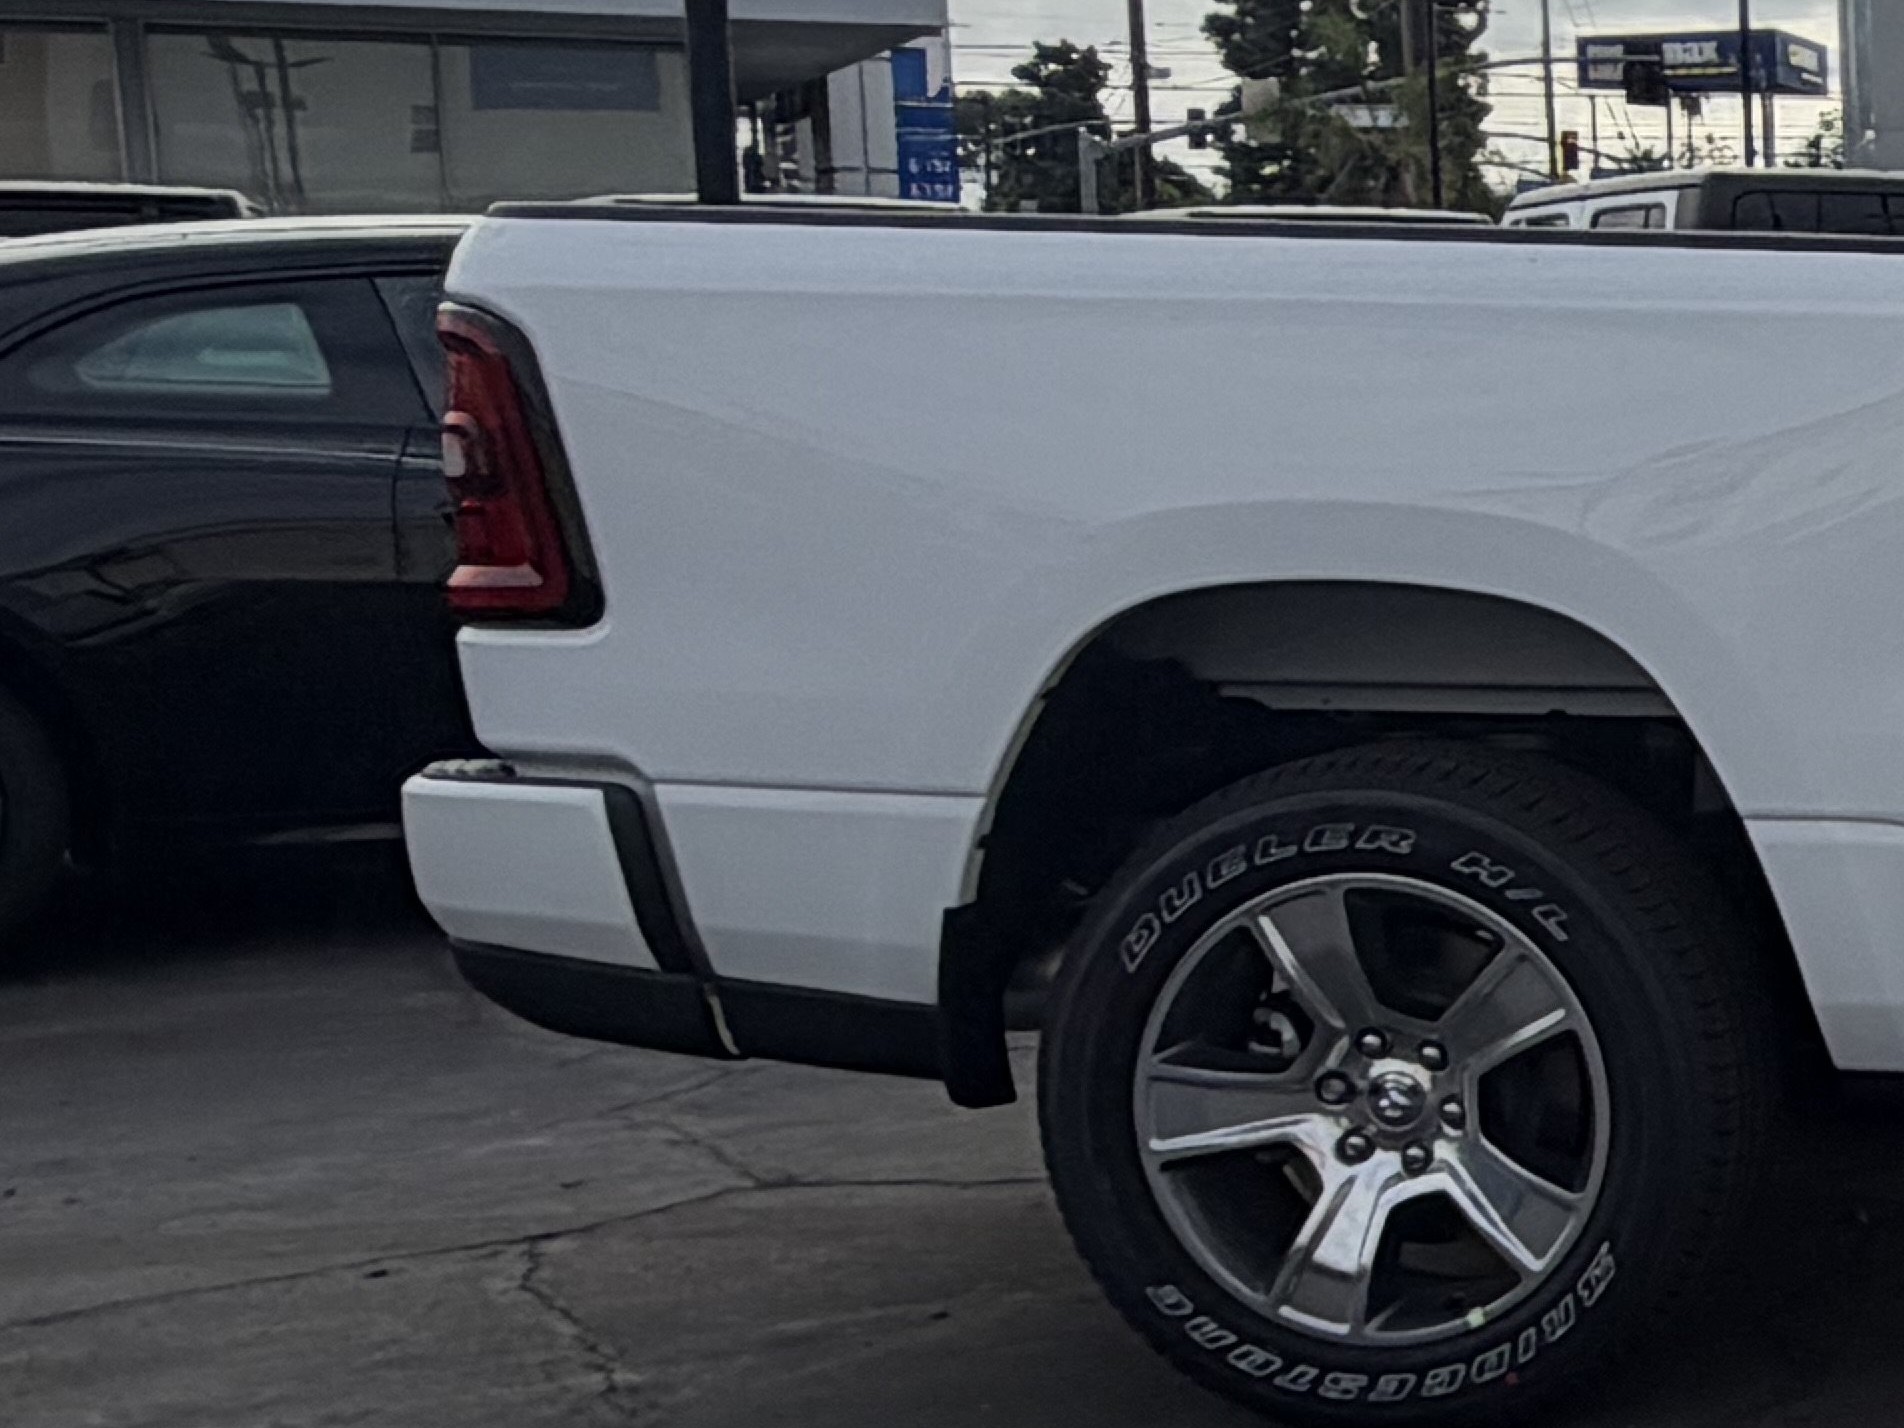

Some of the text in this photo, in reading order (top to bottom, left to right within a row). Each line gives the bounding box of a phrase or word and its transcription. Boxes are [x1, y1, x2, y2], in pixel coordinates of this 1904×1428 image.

[1119, 822, 1569, 972] DUELER H/L
[1145, 1240, 1617, 1402] BRIDGESTONE
